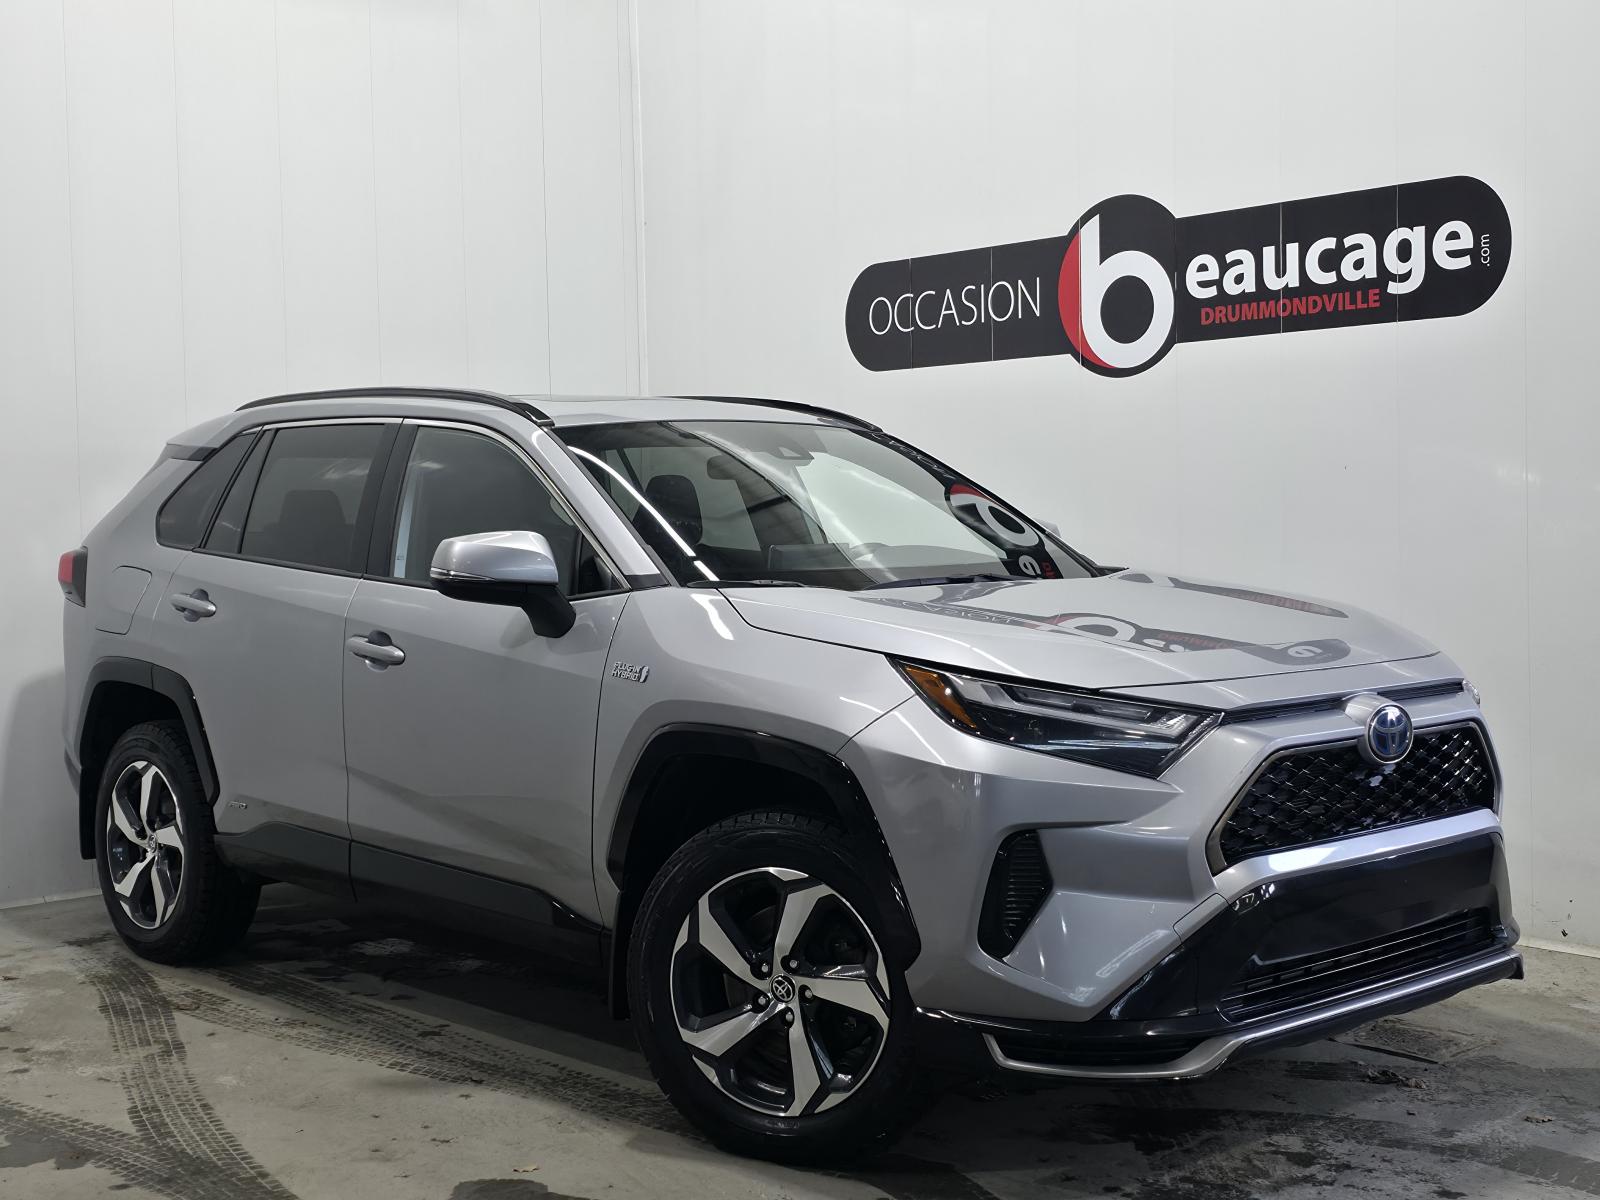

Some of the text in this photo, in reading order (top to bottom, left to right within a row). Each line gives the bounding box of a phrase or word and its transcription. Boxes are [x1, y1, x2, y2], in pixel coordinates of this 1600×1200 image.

[1480, 233, 1490, 267] .com
[869, 277, 1040, 335] OCCASION
[1200, 288, 1381, 326] DRUMMONDVILLE
